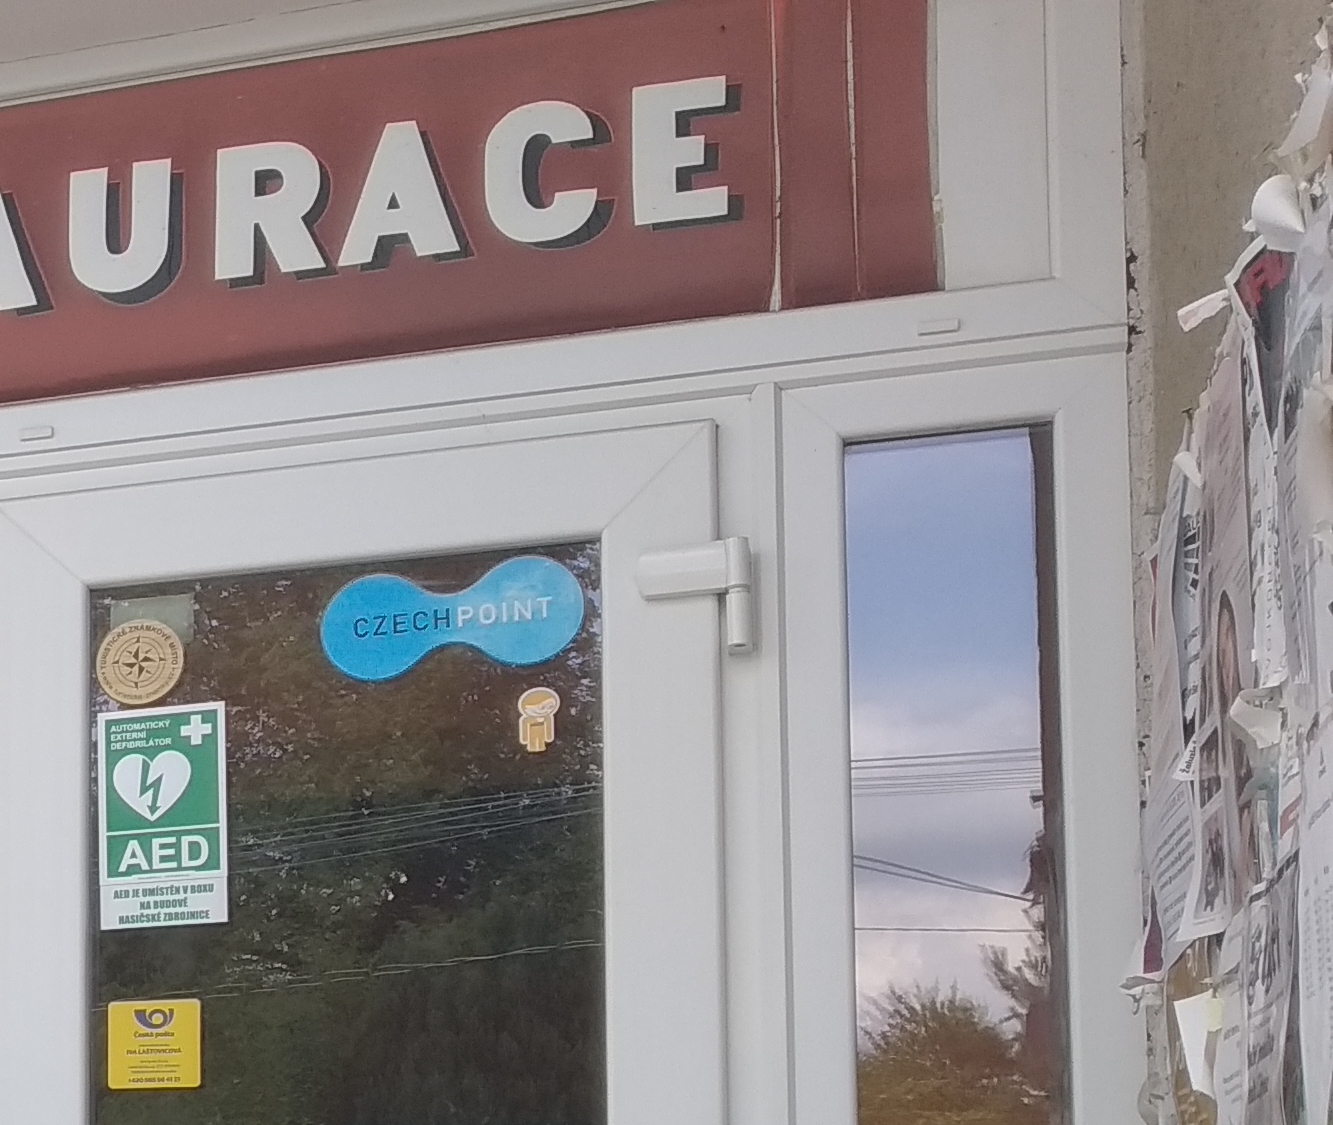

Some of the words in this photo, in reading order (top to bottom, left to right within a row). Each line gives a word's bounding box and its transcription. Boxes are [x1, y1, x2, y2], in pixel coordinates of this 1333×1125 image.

[110, 719, 171, 733] AUTOMATICKÝ
[110, 730, 147, 742] EXTERNÍ
[110, 737, 172, 751] DEFIBRILÁTOR
[117, 835, 209, 873] AED
[113, 889, 130, 900] AED
[132, 888, 140, 899] JE
[141, 884, 181, 898] UMÍSTĚN
[182, 885, 189, 895] V
[190, 883, 214, 894] BOXU
[139, 900, 152, 911] NA
[152, 896, 188, 909] BUDOVĚ
[118, 911, 162, 925] HASIČSKÉ
[162, 909, 211, 922] ZBROJNICE
